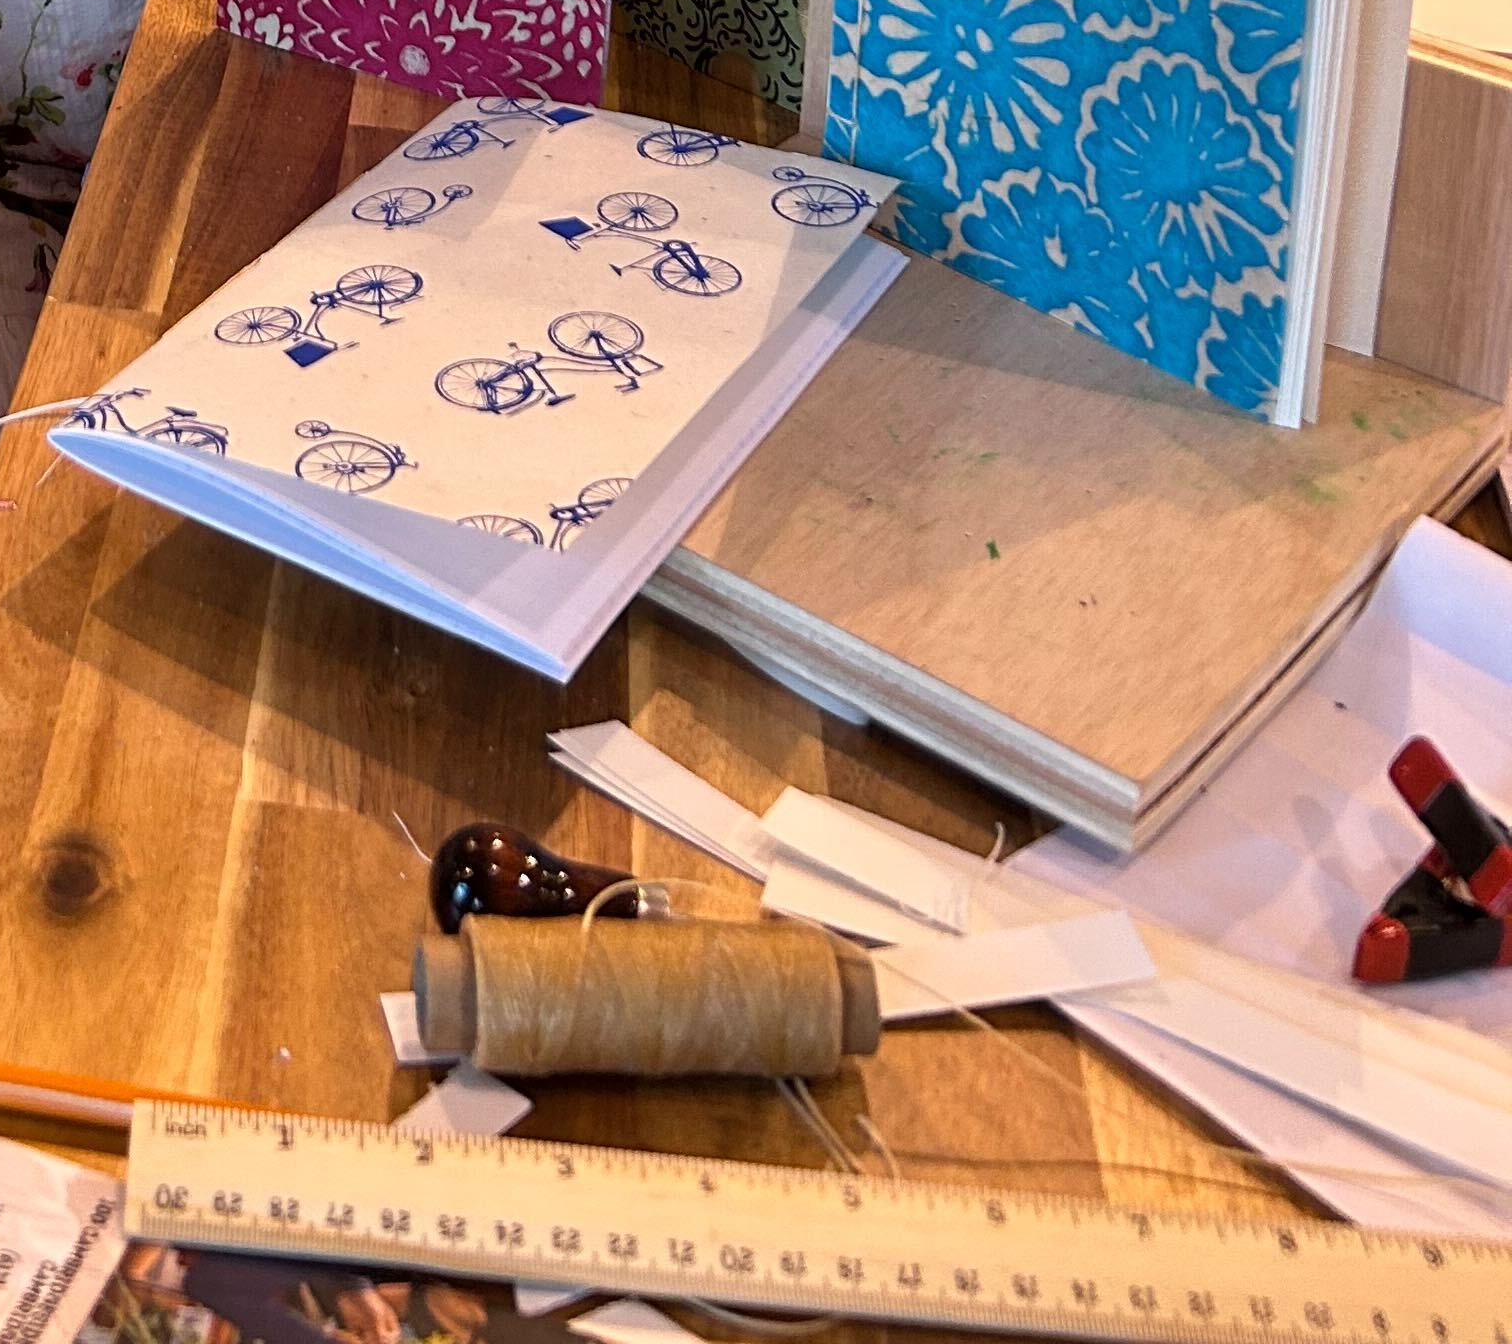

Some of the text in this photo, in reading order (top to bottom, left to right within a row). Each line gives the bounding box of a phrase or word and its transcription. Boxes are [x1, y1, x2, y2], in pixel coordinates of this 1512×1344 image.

[278, 1123, 294, 1151] 1
[415, 1138, 433, 1164] 2
[555, 1154, 575, 1179] 3
[154, 1183, 189, 1211] 30
[213, 1189, 243, 1214] 29
[269, 1195, 300, 1223] 28
[326, 1201, 355, 1226] 27
[381, 1208, 411, 1234] 26
[438, 1213, 468, 1239] 25
[494, 1219, 525, 1247] 24
[551, 1226, 582, 1253] 23
[608, 1232, 639, 1259] 22
[668, 1238, 698, 1265] 21
[719, 1244, 755, 1273] 20
[780, 1250, 807, 1279] 19
